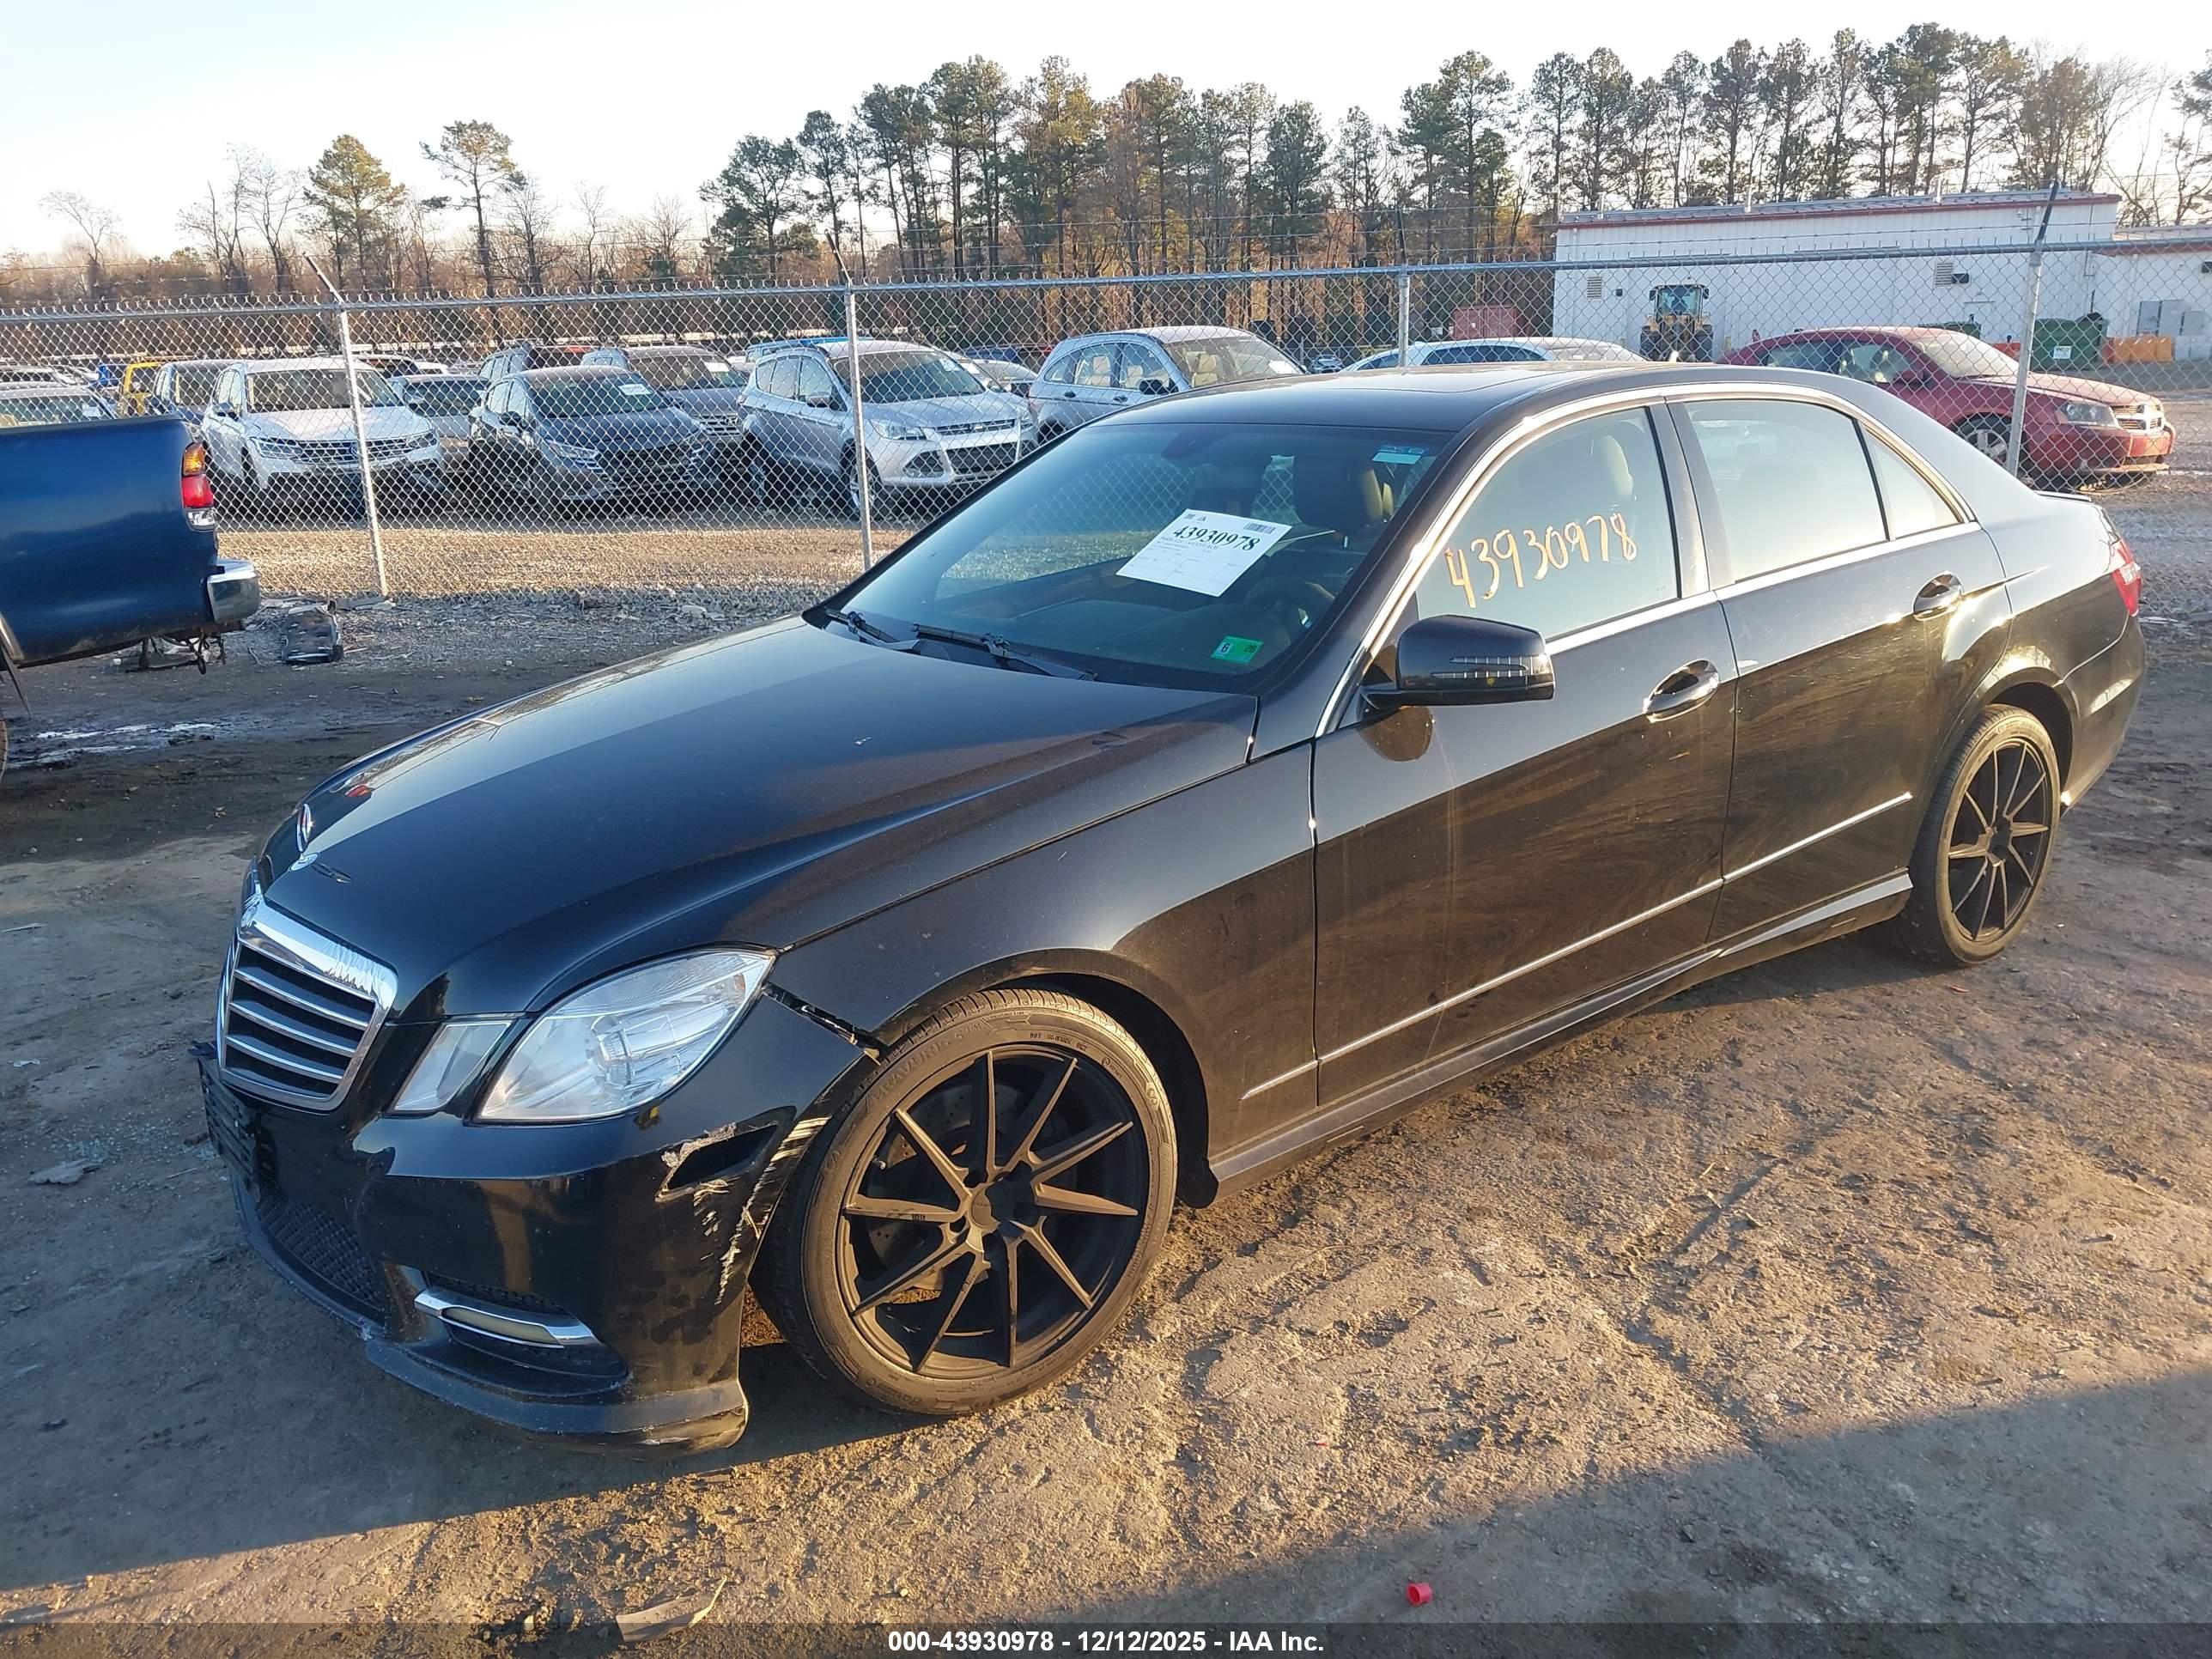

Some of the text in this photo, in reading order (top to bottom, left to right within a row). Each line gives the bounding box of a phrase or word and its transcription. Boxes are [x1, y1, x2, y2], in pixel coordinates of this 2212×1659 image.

[1172, 525, 1261, 551] 43930978
[1444, 512, 1638, 609] 43930978
[1220, 642, 1231, 653] 6
